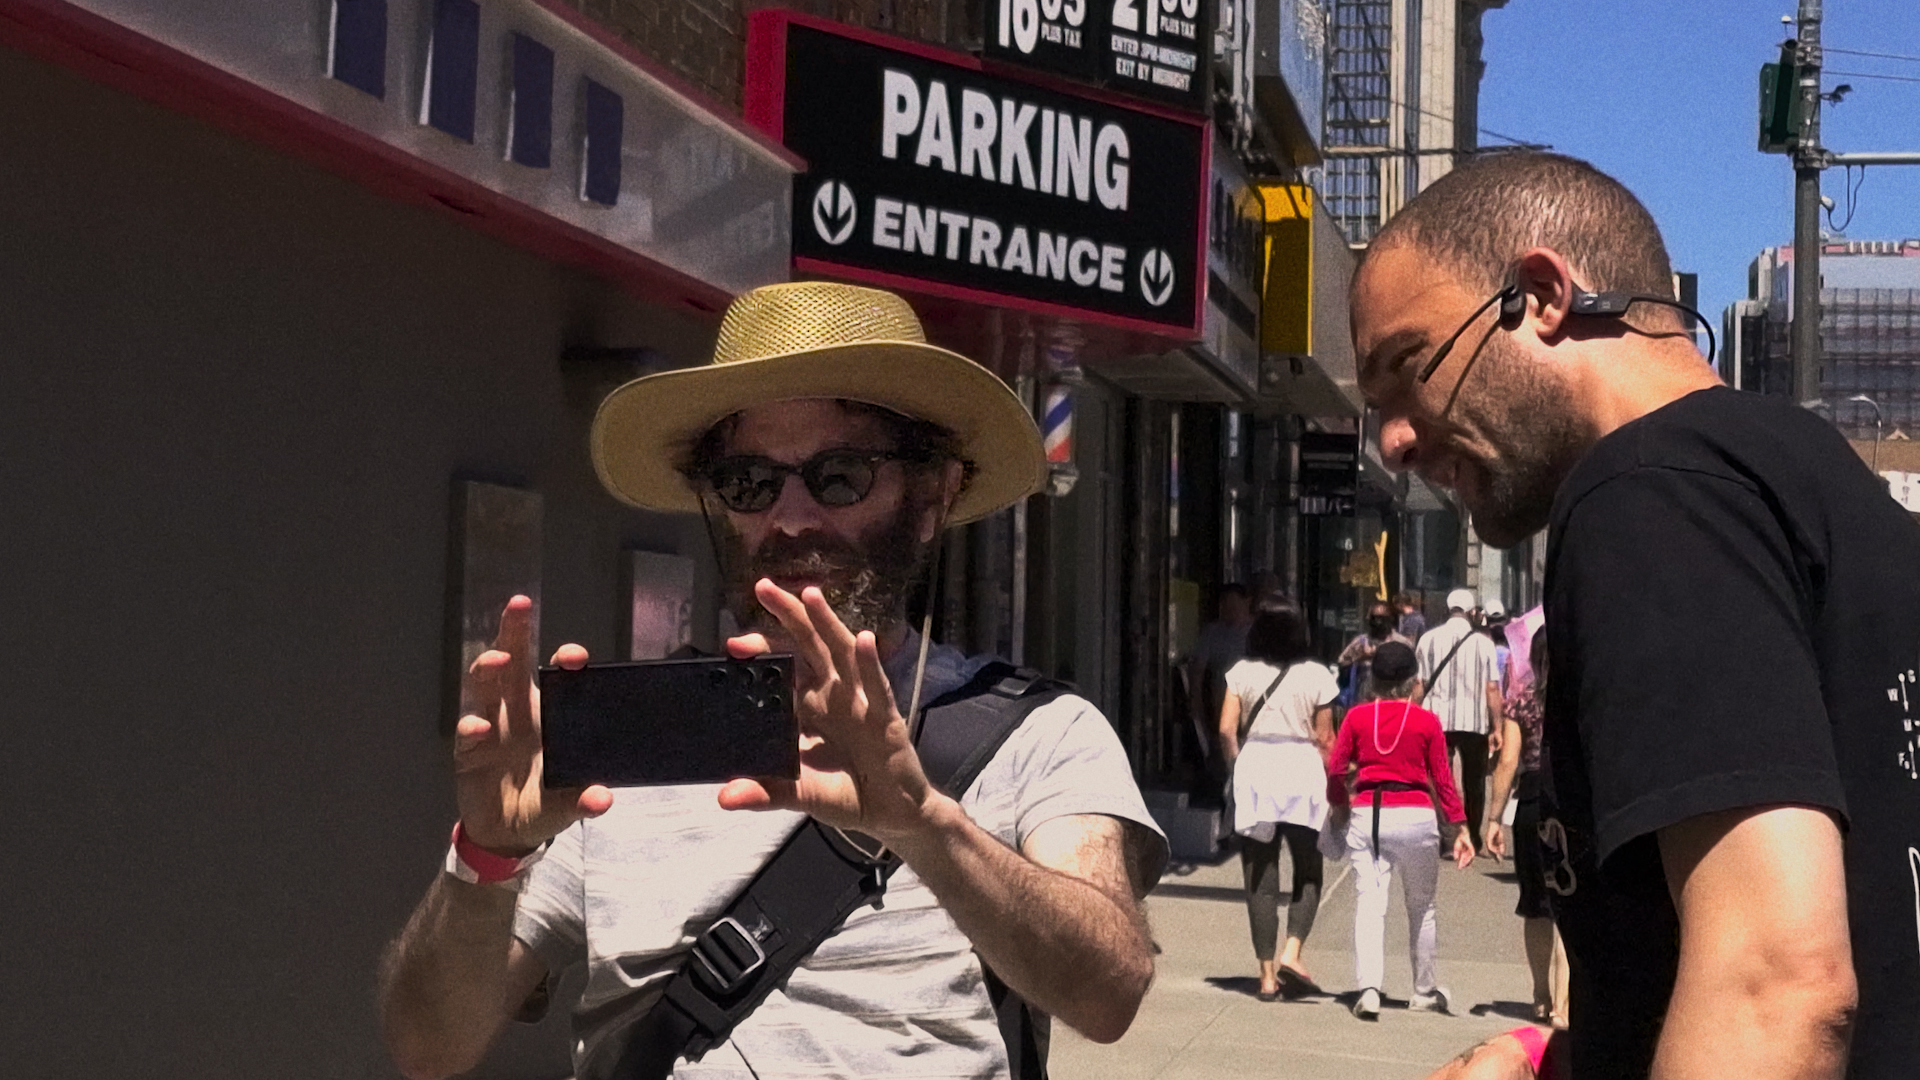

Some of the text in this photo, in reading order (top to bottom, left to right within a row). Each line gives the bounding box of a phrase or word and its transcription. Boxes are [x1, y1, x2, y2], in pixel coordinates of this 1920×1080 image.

[1041, 22, 1082, 48] PLUS TAX
[1160, 15, 1180, 35] PLUS
[1180, 21, 1196, 39] TAX
[882, 69, 1131, 211] PARKING
[872, 197, 1127, 292] ENTRANCE
